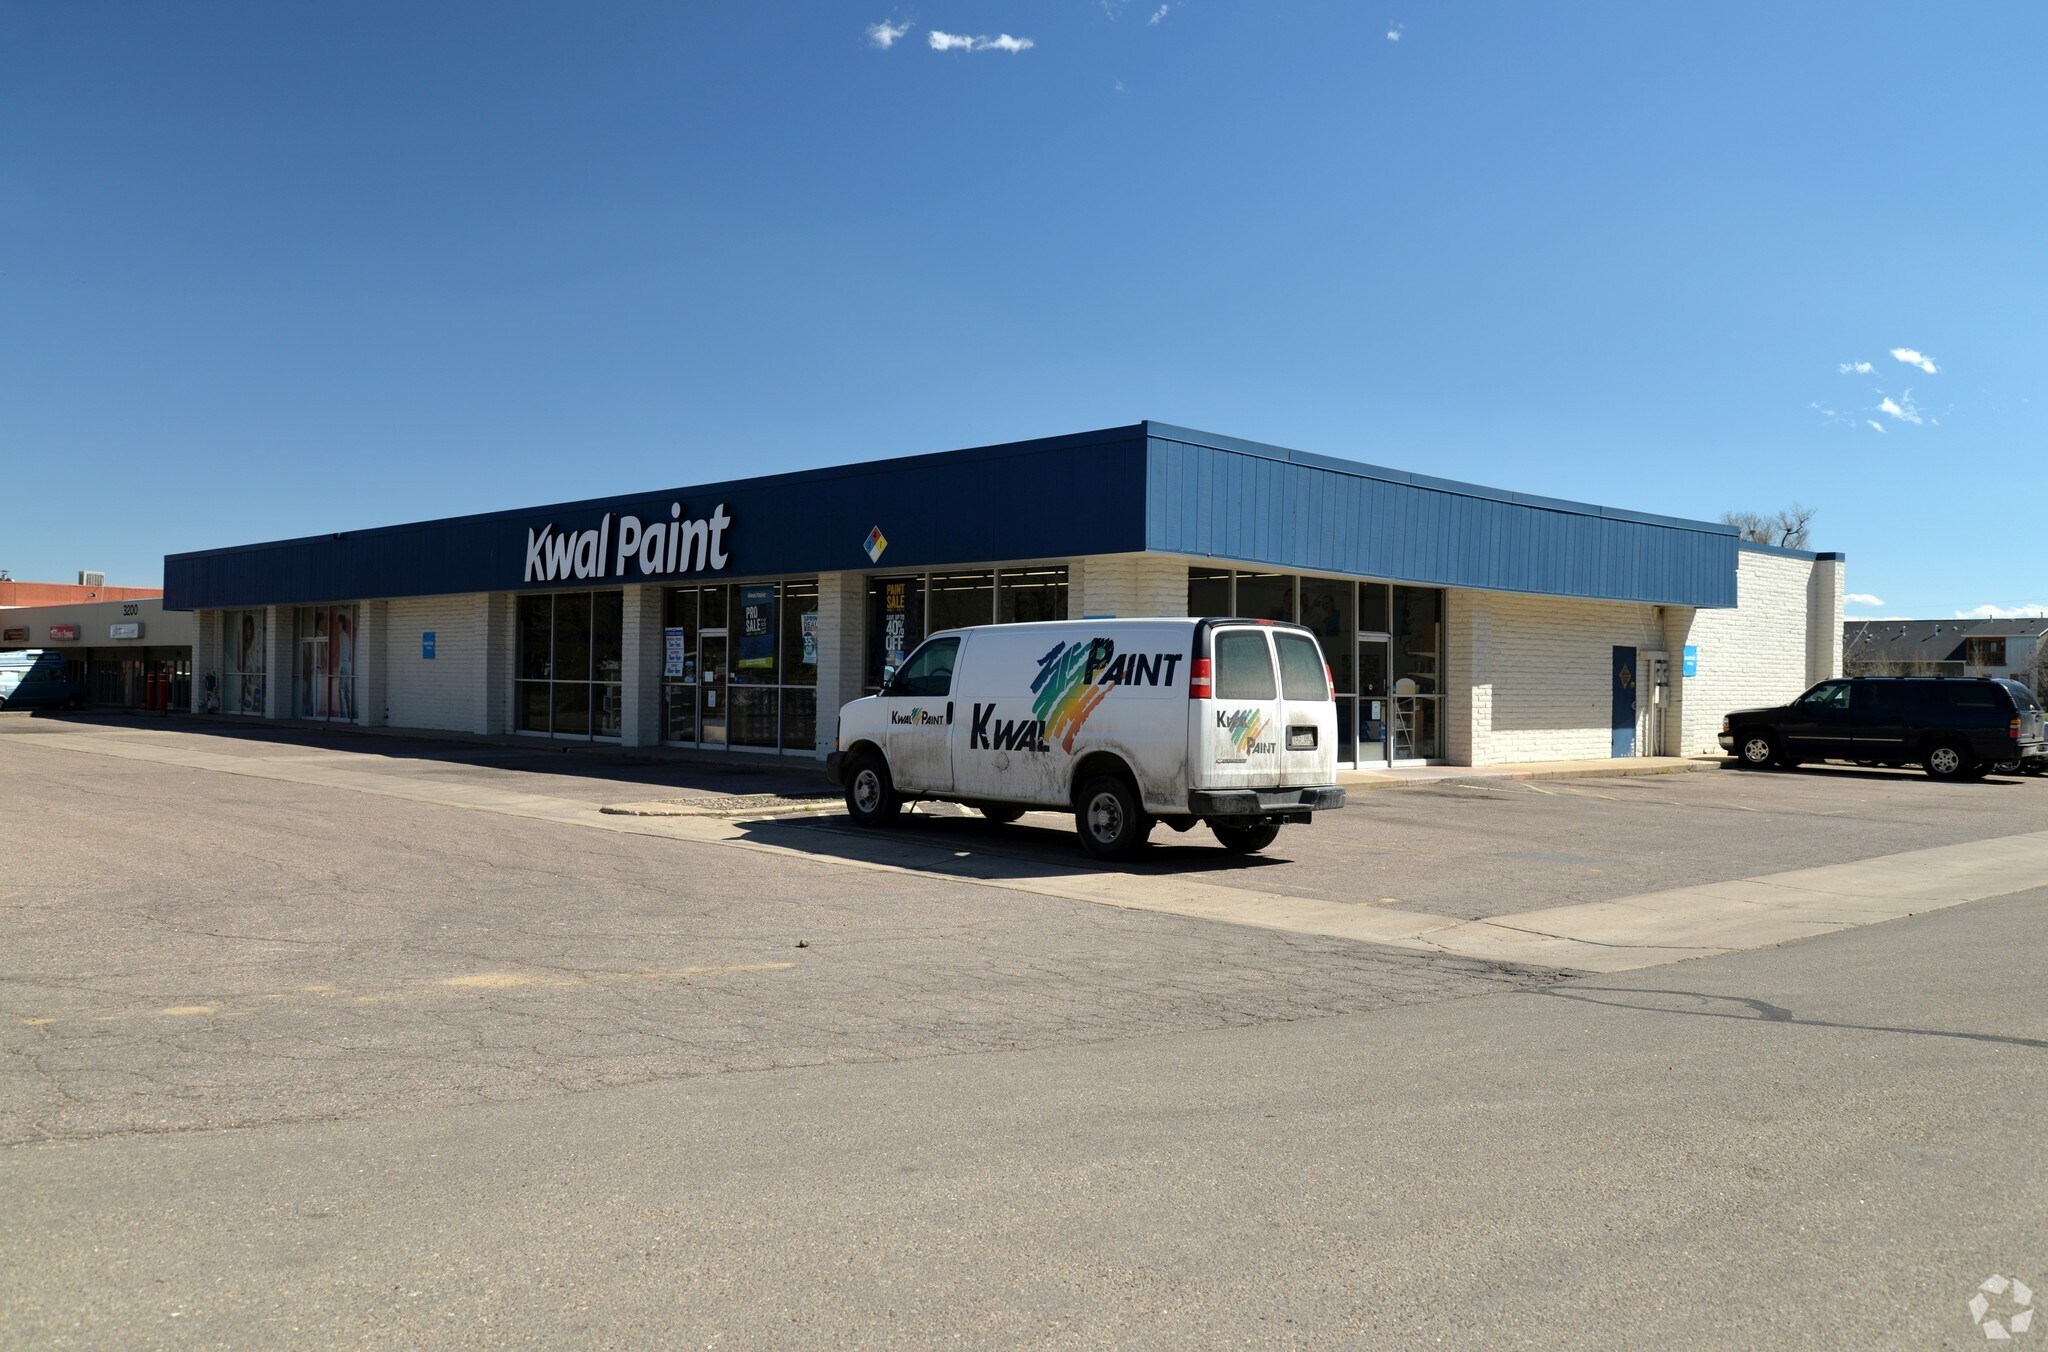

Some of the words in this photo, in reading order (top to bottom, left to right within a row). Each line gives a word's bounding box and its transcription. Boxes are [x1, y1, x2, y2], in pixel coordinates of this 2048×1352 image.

[524, 512, 611, 582] Kwal
[616, 502, 731, 576] Paint
[886, 584, 906, 595] PAINT
[886, 595, 905, 609] SALE
[123, 604, 138, 616] 3200
[745, 605, 758, 619] PRO
[745, 618, 761, 633] SALE
[886, 620, 905, 635] 40%
[885, 635, 905, 651] OFF
[1083, 637, 1182, 686] PAINT
[891, 710, 913, 725] KWAL
[921, 710, 944, 725] PAINT
[970, 703, 1050, 752] KWAL
[1246, 736, 1277, 755] PAINT
